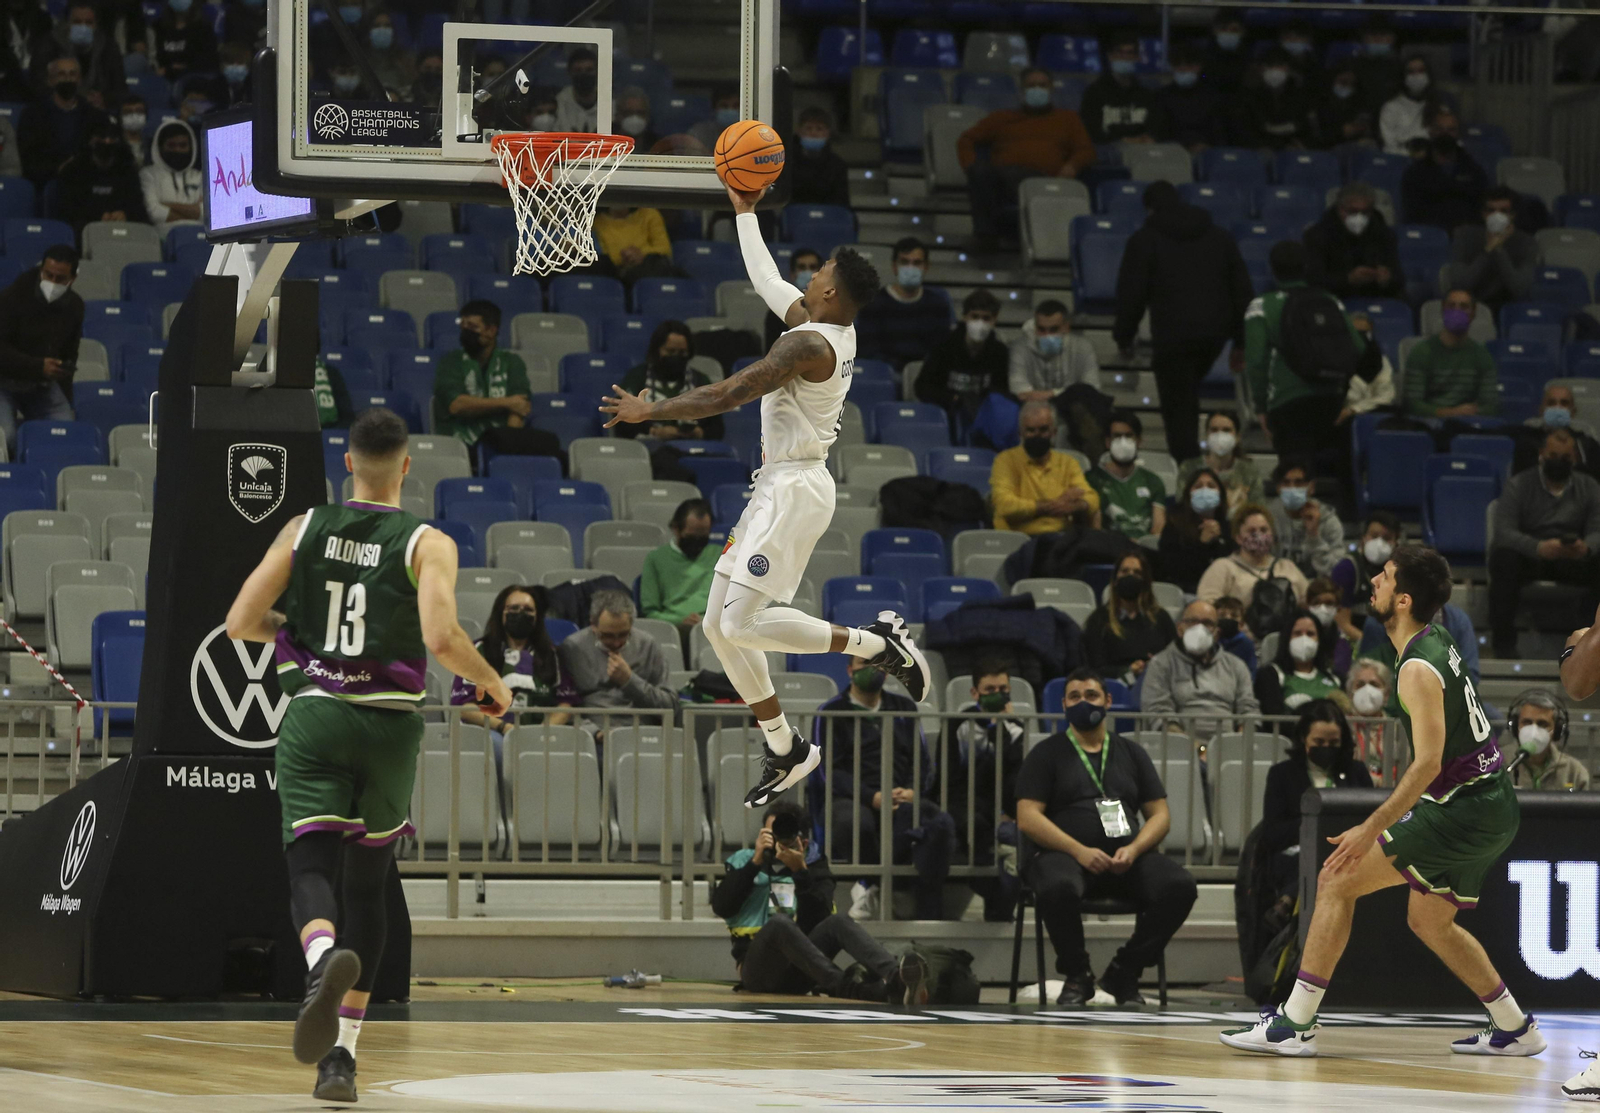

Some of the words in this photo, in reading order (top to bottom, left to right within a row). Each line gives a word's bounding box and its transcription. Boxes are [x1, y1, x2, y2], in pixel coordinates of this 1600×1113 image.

[351, 109, 412, 119] BASKETBALL
[351, 118, 420, 129] CHAMPIONS
[351, 128, 388, 137] LEAGUE
[239, 481, 272, 493] Unicaja
[238, 492, 273, 500] Baloncesto
[324, 535, 382, 568] ALONSO
[323, 580, 367, 657] 13
[166, 766, 256, 793] Málaga
[40, 893, 61, 915] Málaga
[60, 894, 81, 915] Wagen
